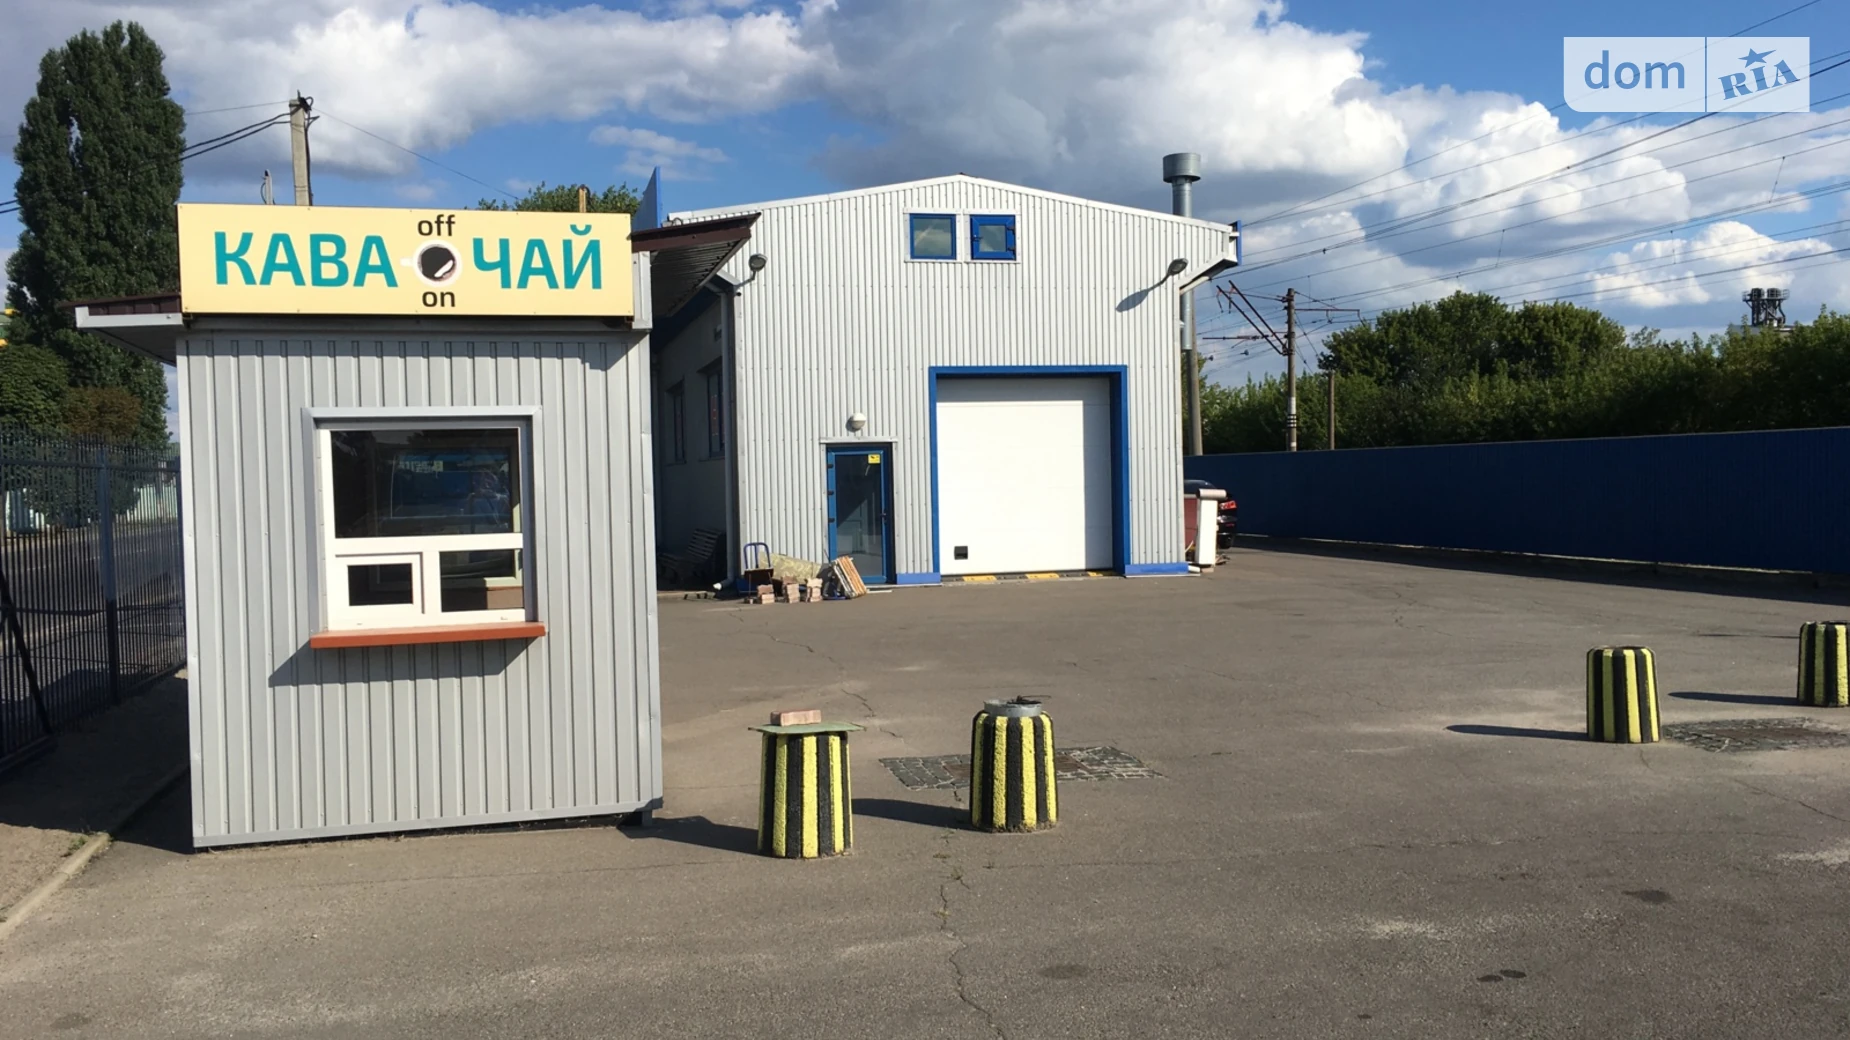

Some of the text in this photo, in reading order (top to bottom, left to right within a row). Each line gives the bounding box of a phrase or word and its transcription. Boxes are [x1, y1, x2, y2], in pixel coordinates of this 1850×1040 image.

[417, 214, 456, 237] off
[214, 224, 603, 290] КАВА ЧАЙ
[421, 290, 457, 308] on
